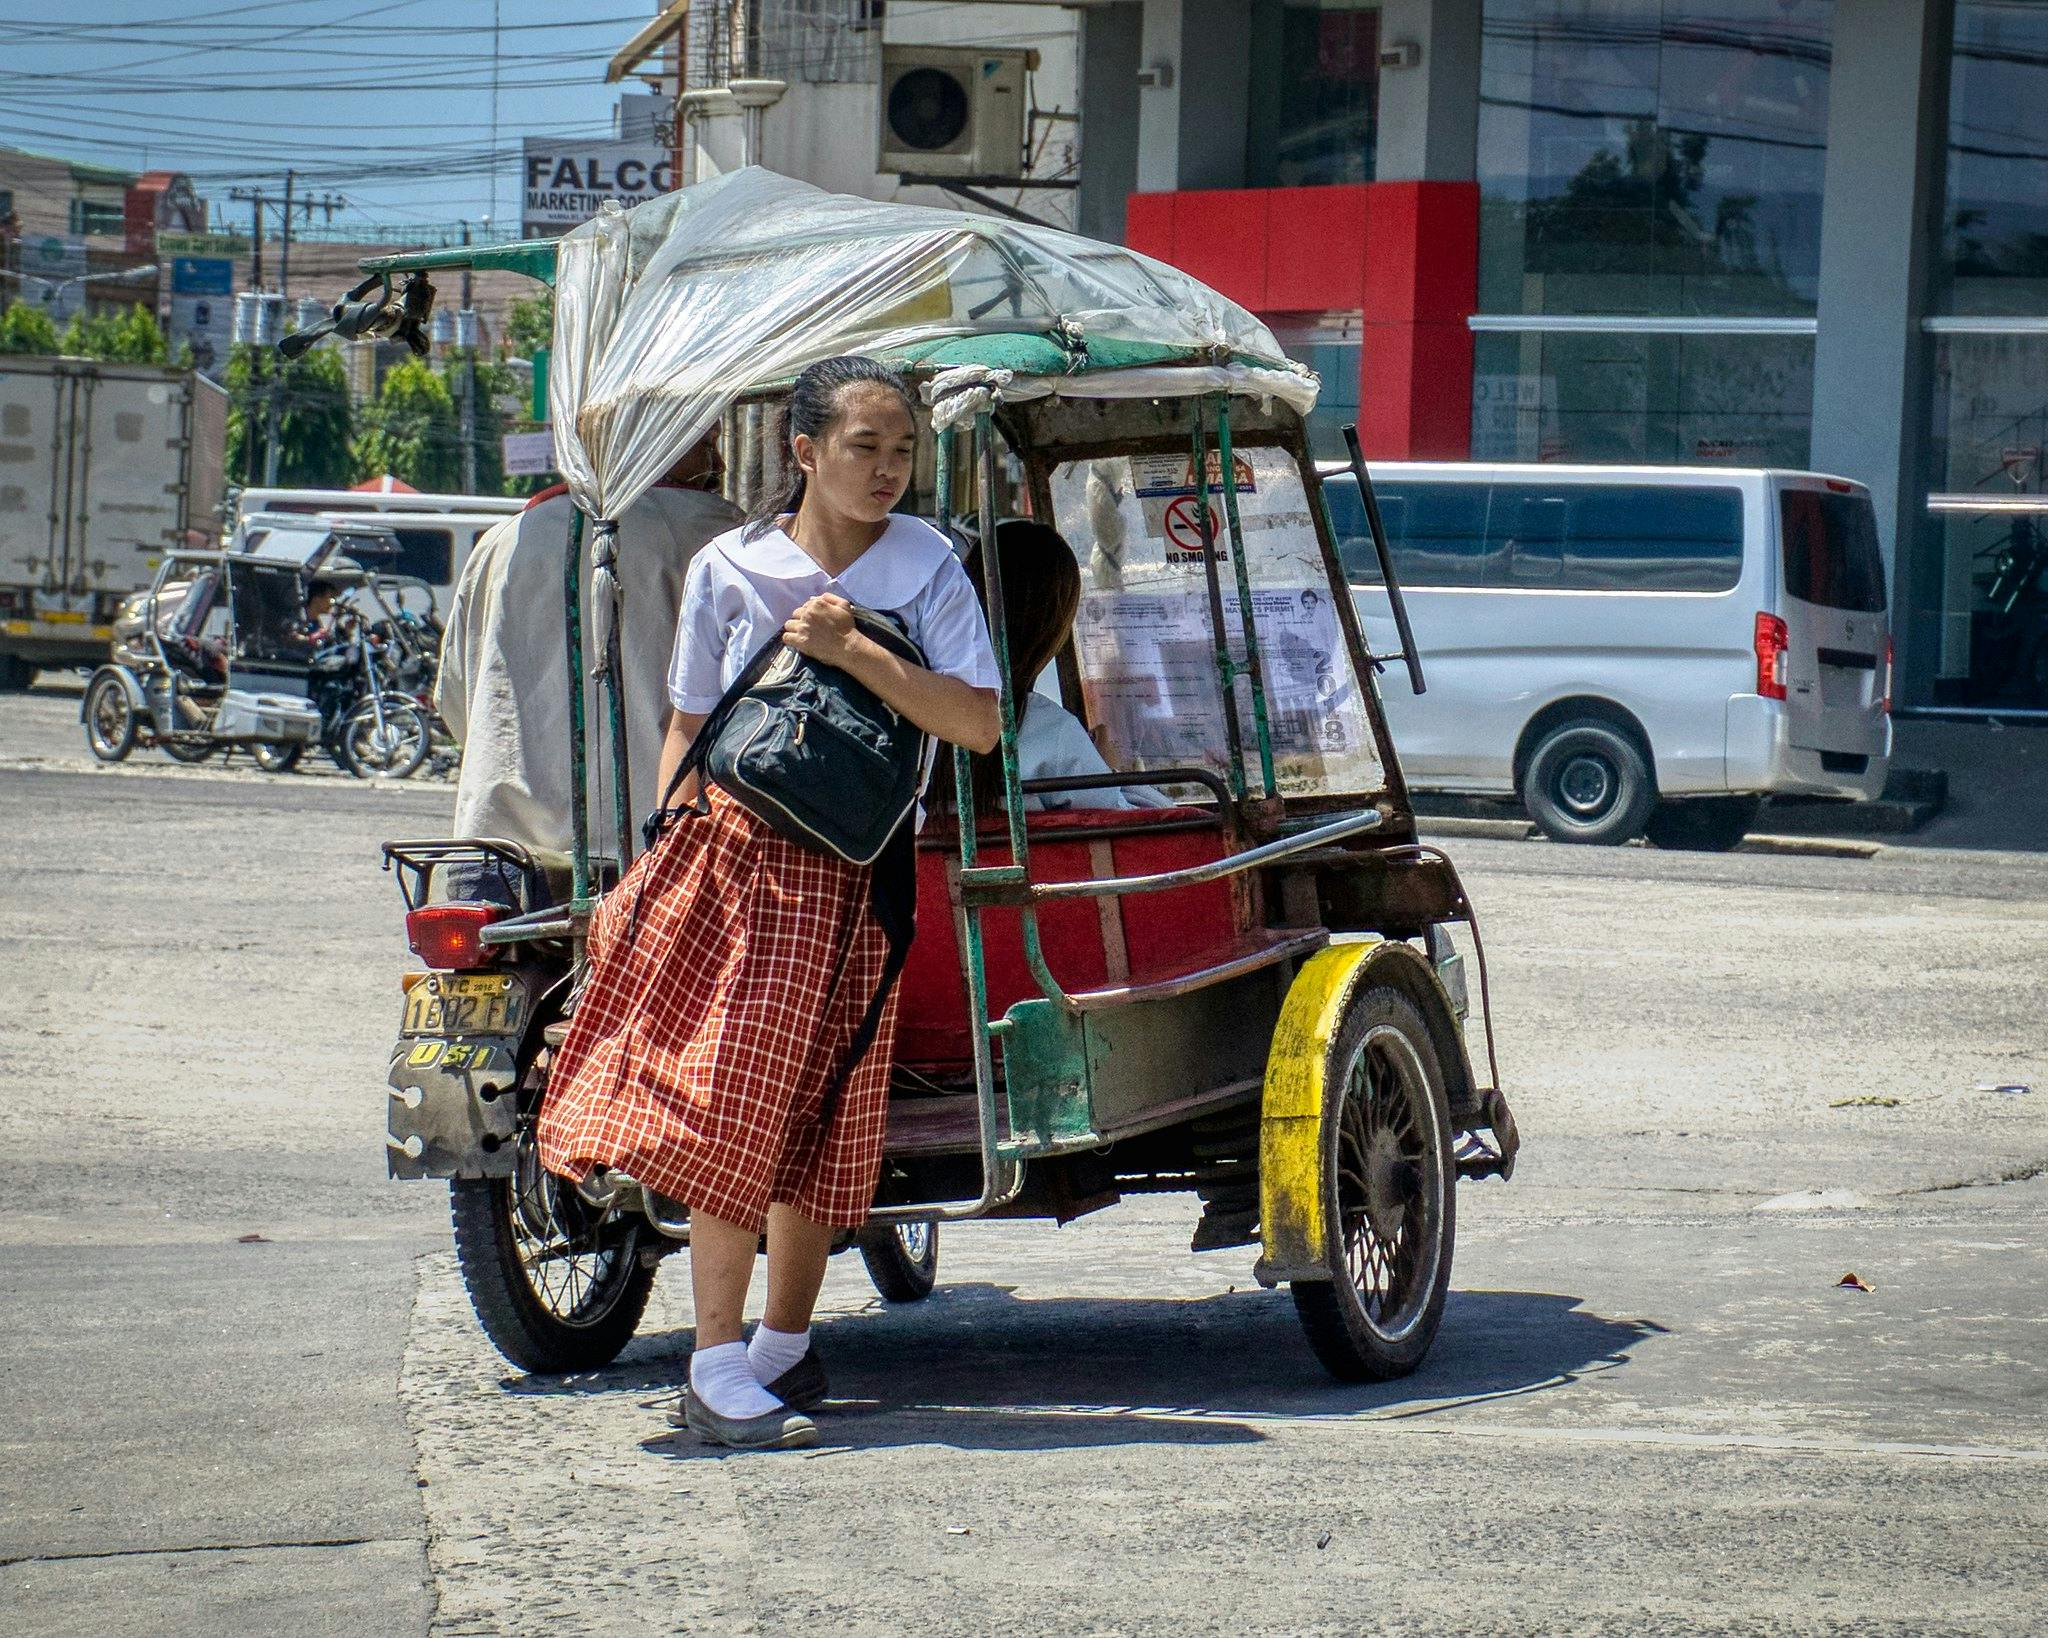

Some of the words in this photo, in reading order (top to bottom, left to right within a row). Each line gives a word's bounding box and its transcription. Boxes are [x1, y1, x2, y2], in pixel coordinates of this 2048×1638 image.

[1167, 552, 1179, 563] NO
[1182, 550, 1228, 562] SMONG
[1264, 605, 1295, 613] PERMIT
